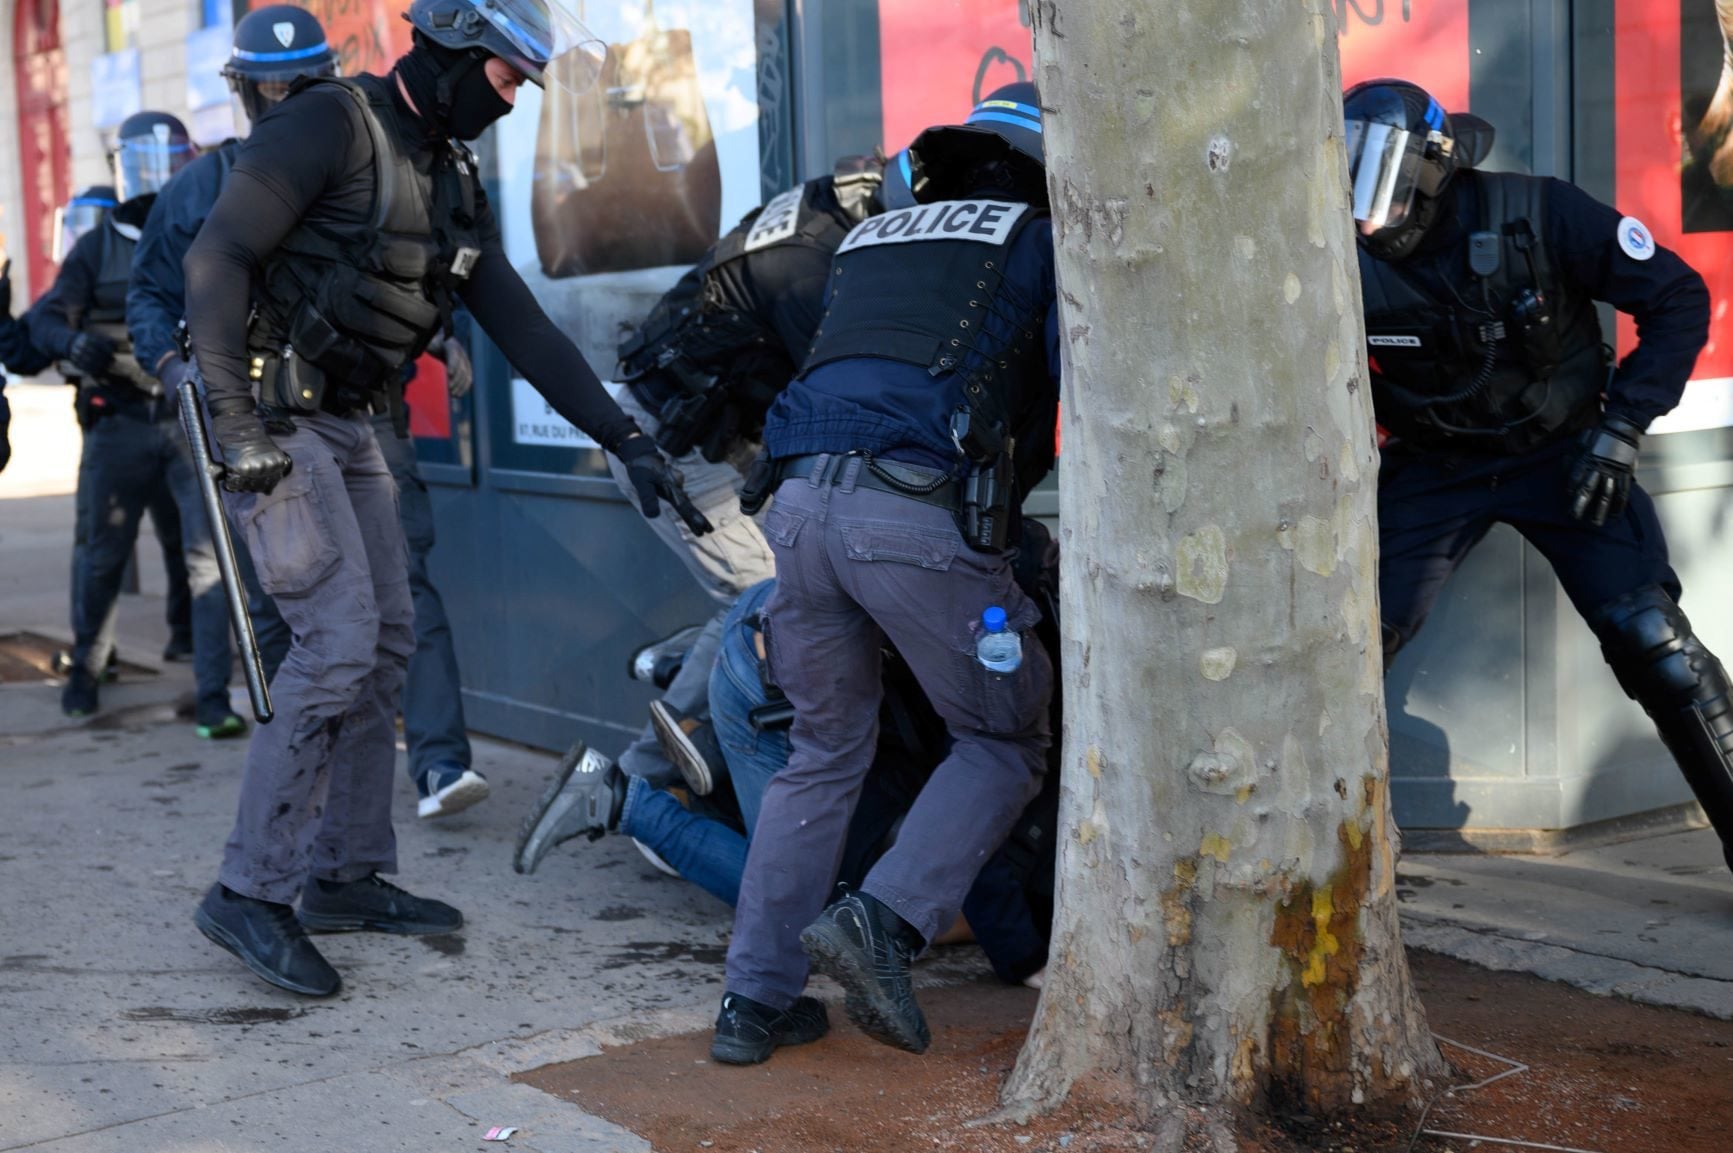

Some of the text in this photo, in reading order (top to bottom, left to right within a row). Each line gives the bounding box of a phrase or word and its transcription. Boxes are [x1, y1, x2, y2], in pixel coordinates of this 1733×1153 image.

[849, 203, 1012, 244] POLICE
[1371, 337, 1418, 345] POLICE
[532, 424, 549, 438] RUE
[552, 425, 566, 439] DU
